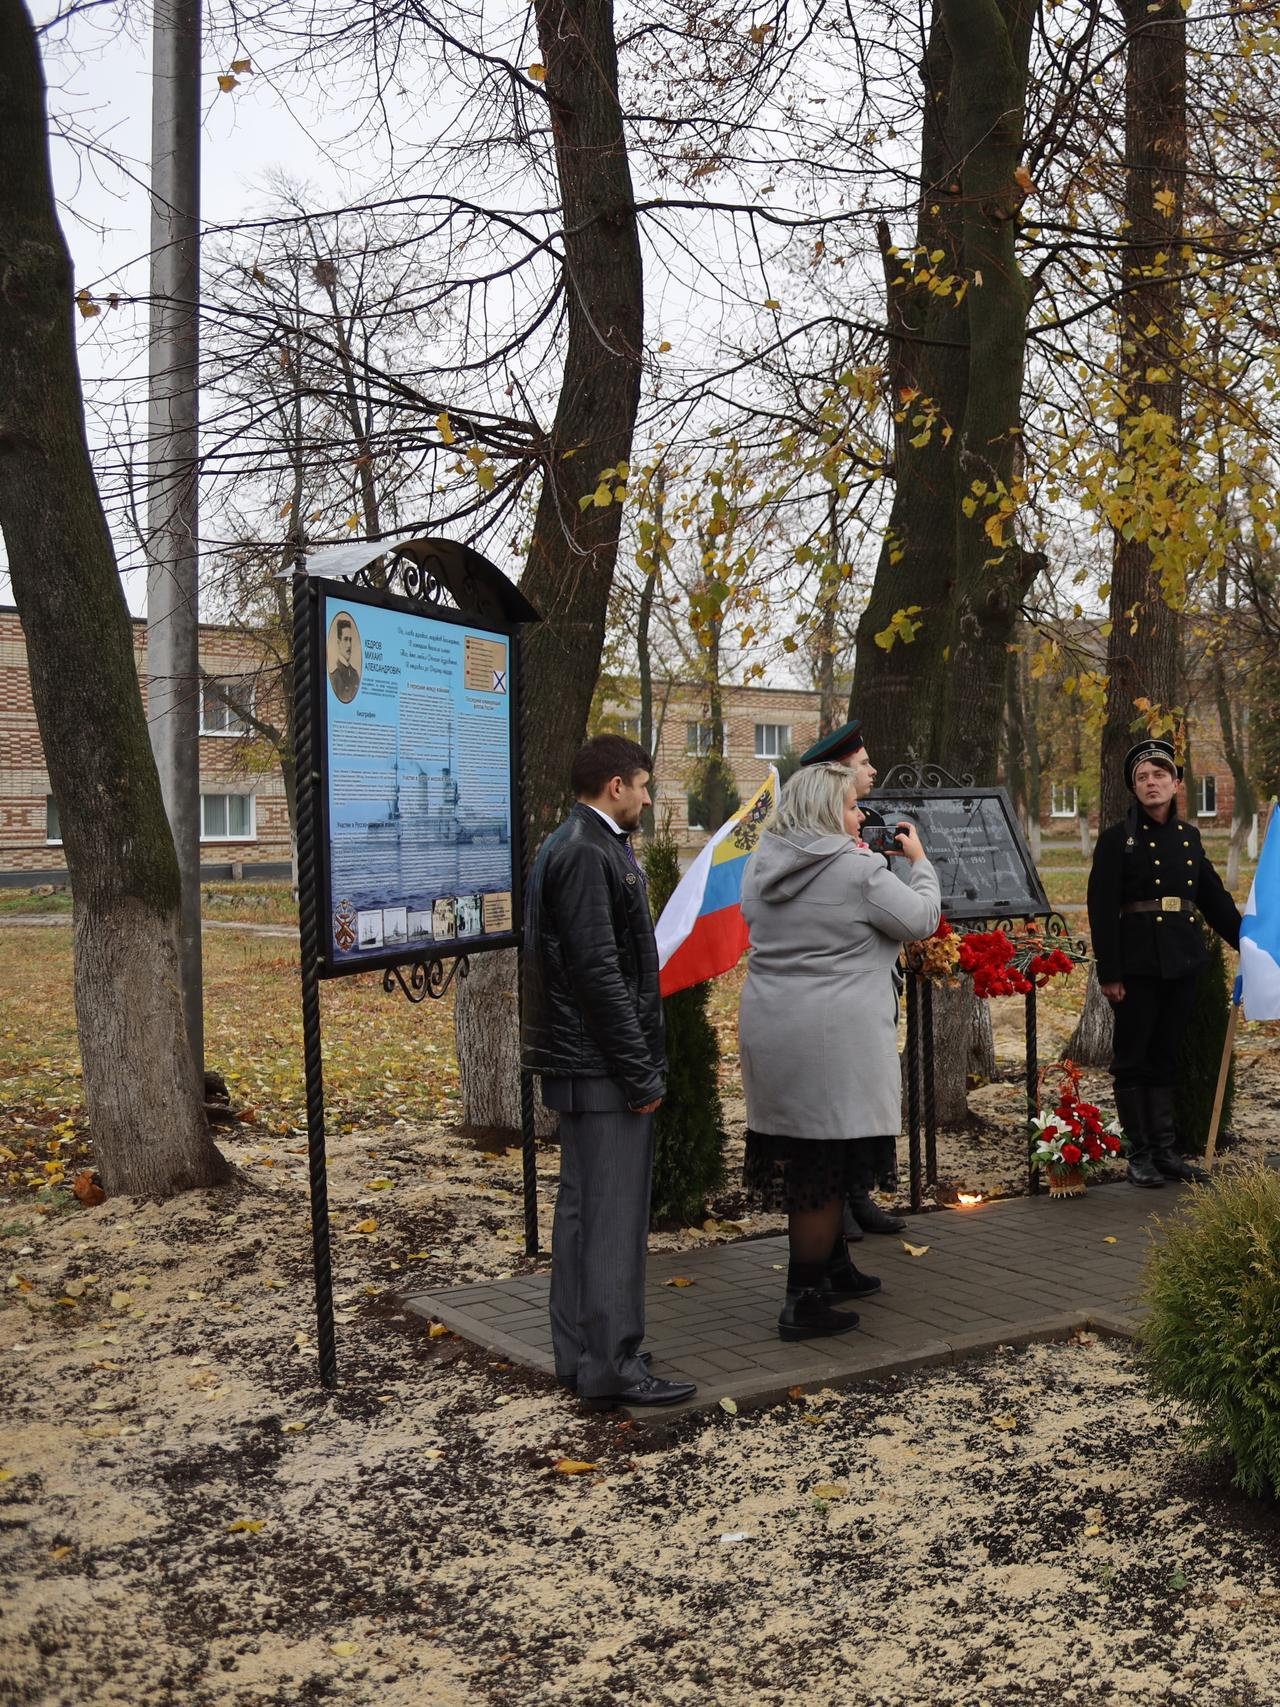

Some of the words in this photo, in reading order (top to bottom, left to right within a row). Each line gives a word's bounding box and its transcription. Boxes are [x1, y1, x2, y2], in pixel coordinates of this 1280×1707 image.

[365, 640, 382, 650] КЕДРОВ
[365, 651, 383, 661] МИХАИЛ
[365, 662, 401, 675] АЛЕКСАНДРОВИЧ
[971, 856, 986, 864] 1945
